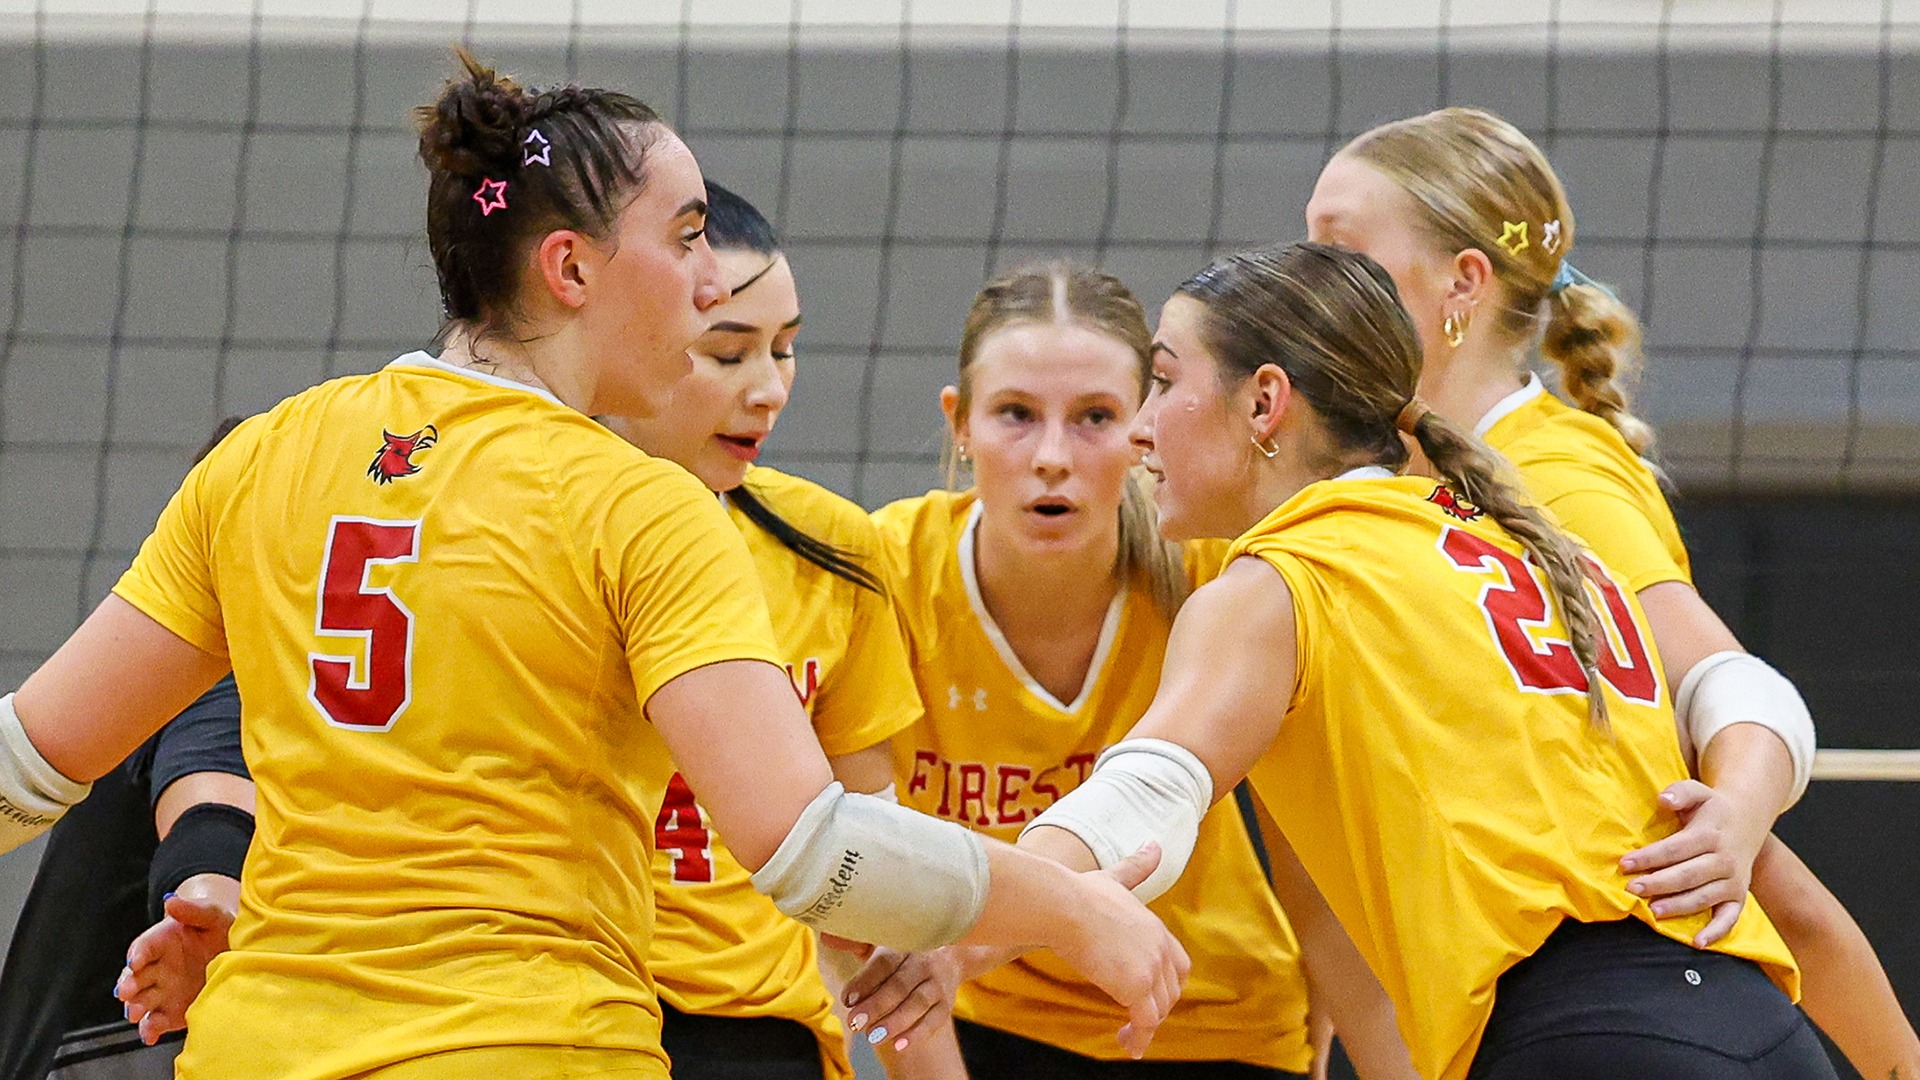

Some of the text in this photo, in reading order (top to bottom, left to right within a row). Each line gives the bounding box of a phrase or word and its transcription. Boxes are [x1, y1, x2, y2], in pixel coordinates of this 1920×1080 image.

[307, 514, 424, 733] 5
[1435, 523, 1662, 708] 20
[908, 749, 1106, 827] FIREST
